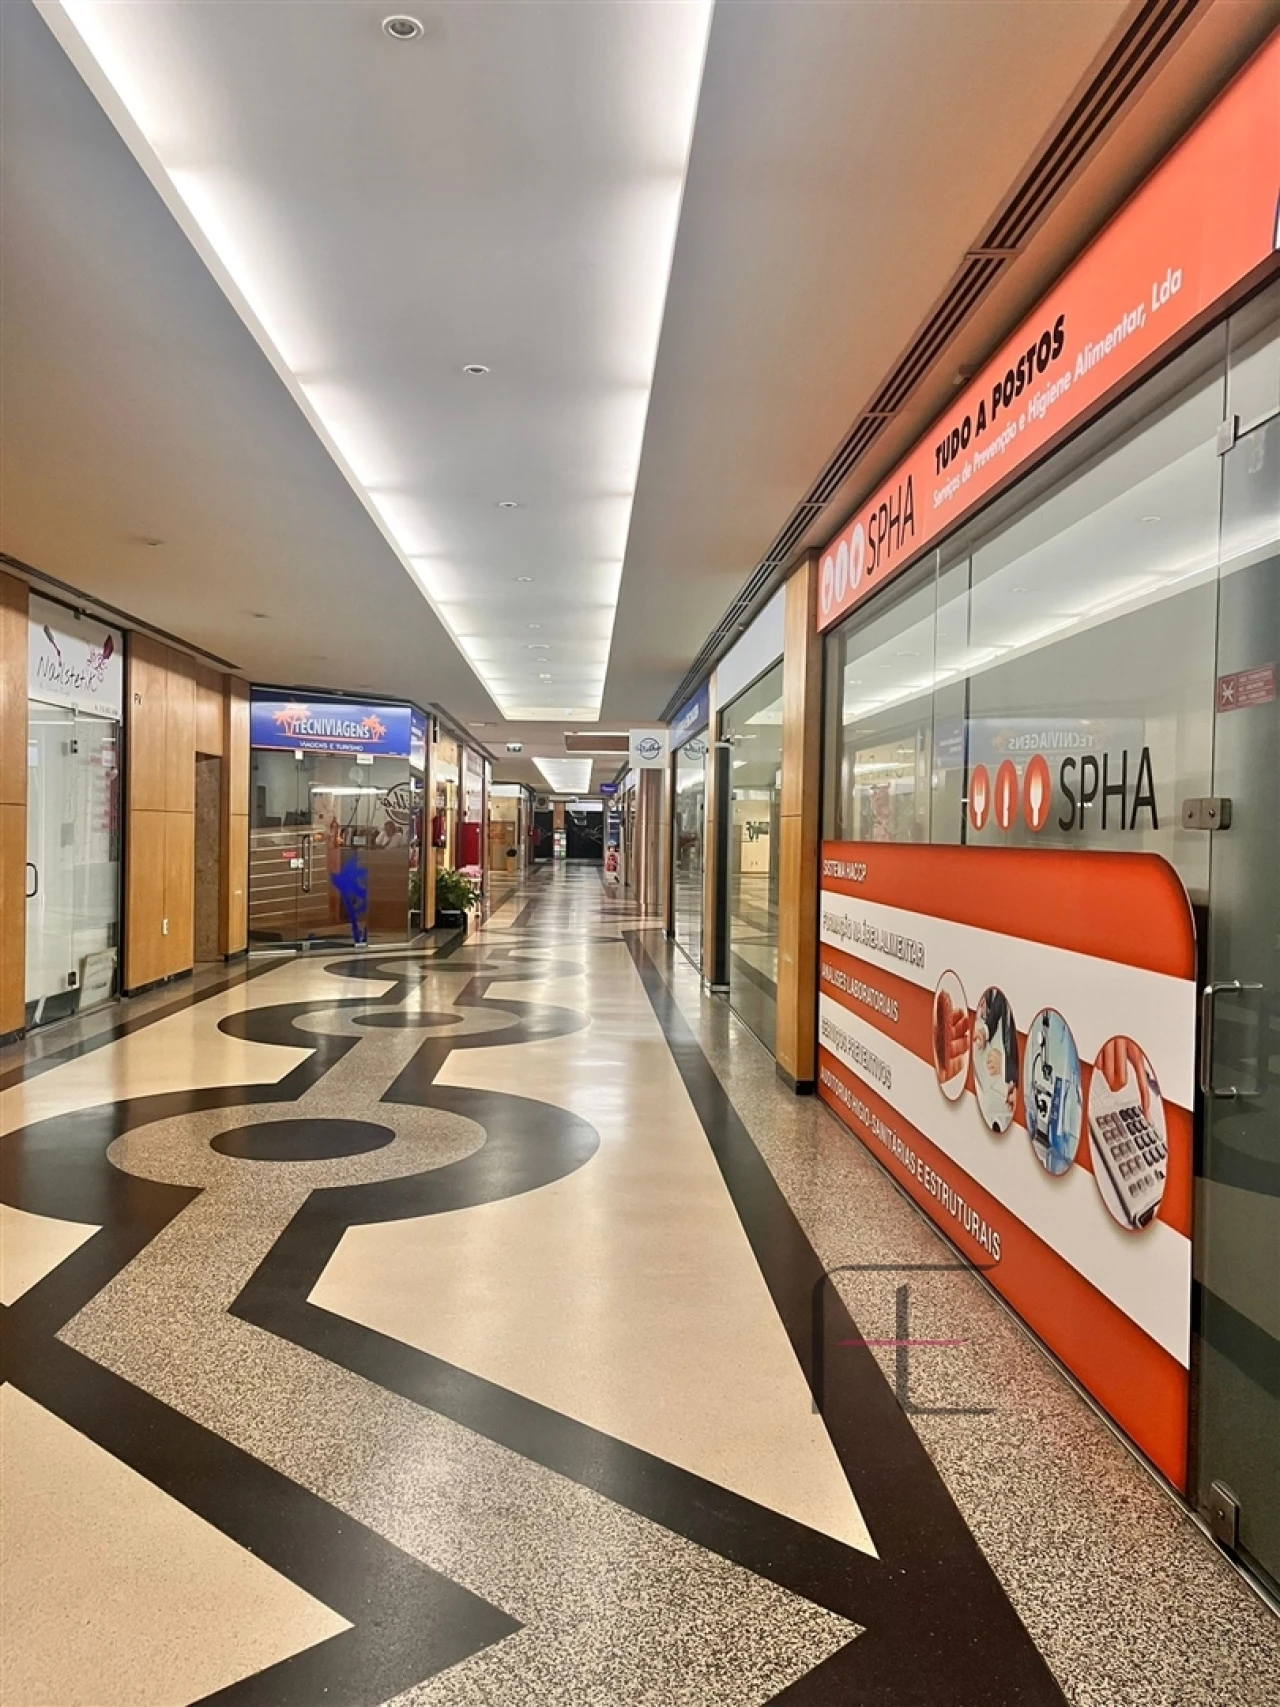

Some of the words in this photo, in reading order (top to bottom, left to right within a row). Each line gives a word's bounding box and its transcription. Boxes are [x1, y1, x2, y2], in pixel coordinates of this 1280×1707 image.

[935, 415, 971, 475] TUDO
[975, 400, 986, 438] A
[992, 314, 1065, 421] POSTOS
[962, 460, 972, 483] de
[973, 421, 1017, 473] Prevenção
[1018, 413, 1026, 432] e
[1028, 369, 1072, 423] Higiene
[1073, 302, 1147, 383] Alimentar,
[1151, 267, 1183, 313] Lda
[867, 474, 915, 576] SPHA
[295, 718, 370, 739] TECNIVIAGENS
[1058, 747, 1159, 832] SPHA
[917, 1158, 924, 1183] E
[923, 1164, 1002, 1262] ESTRUTURAIS
